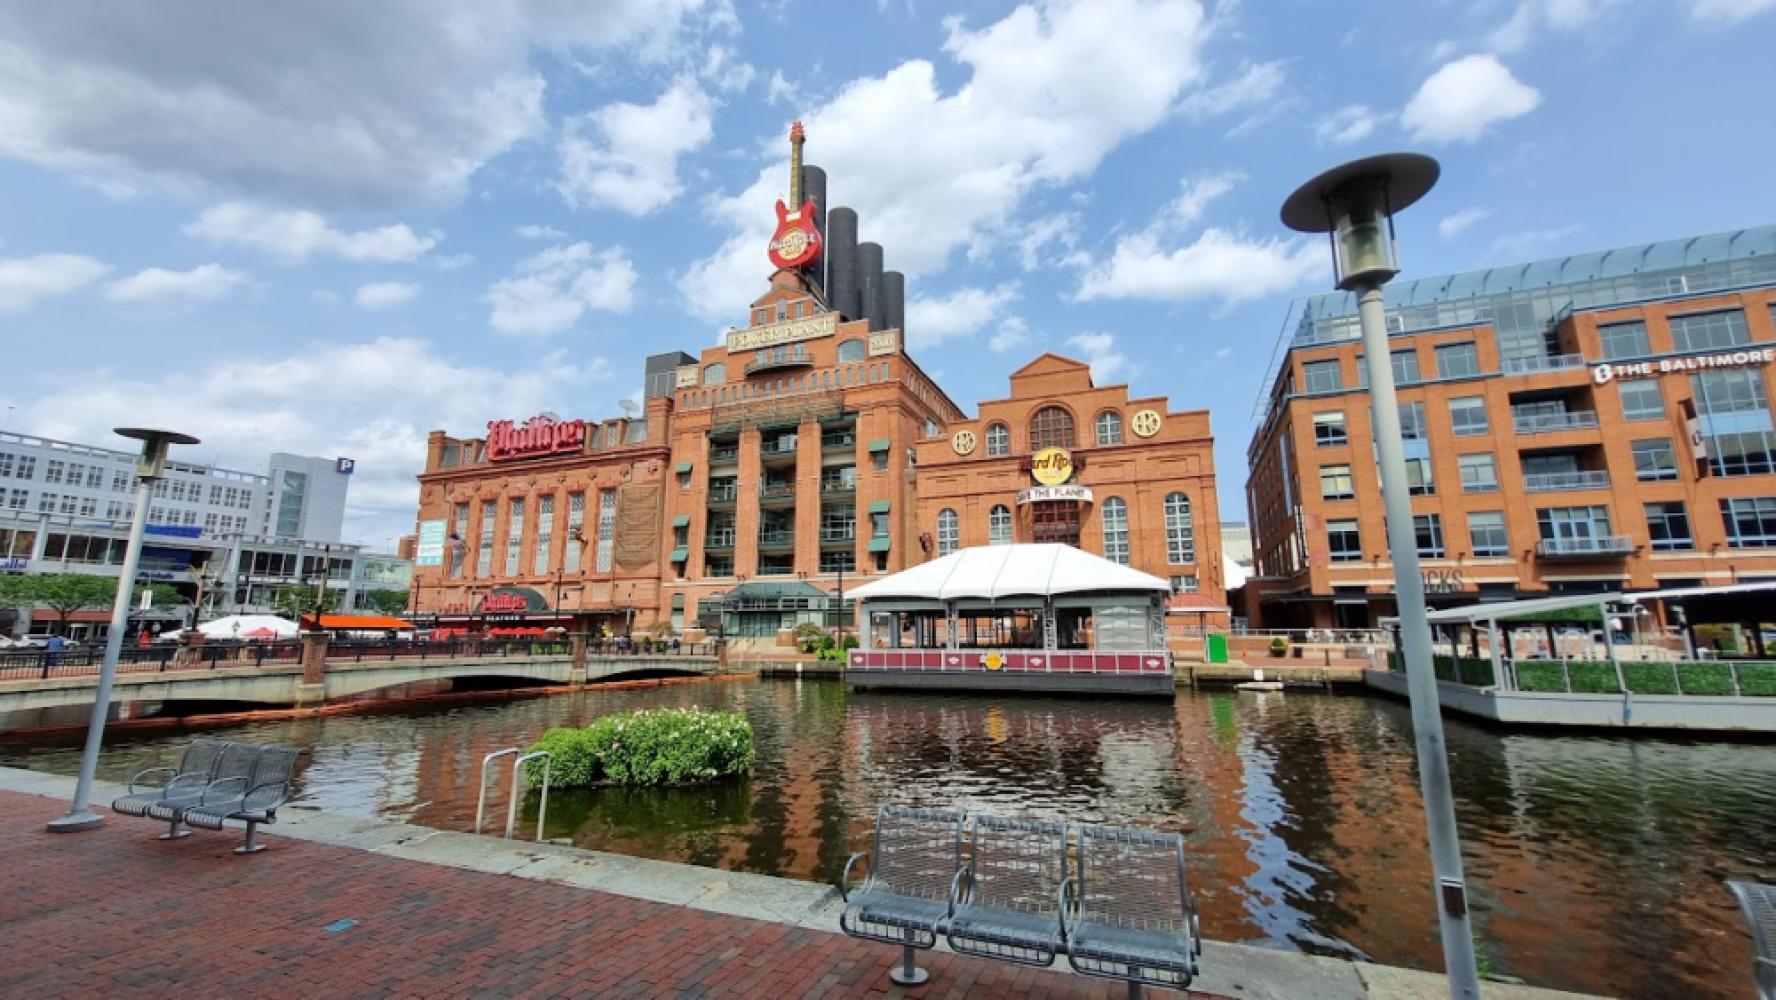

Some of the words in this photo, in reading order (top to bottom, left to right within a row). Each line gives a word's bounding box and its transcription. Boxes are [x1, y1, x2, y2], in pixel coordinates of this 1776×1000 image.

[731, 327, 777, 348] POWER
[784, 318, 831, 338] PLANT
[1615, 362, 1652, 378] THE
[1660, 349, 1775, 373] BALTIMORE
[341, 459, 353, 472] P
[1034, 488, 1051, 499] THE
[1420, 568, 1464, 593] CKS
